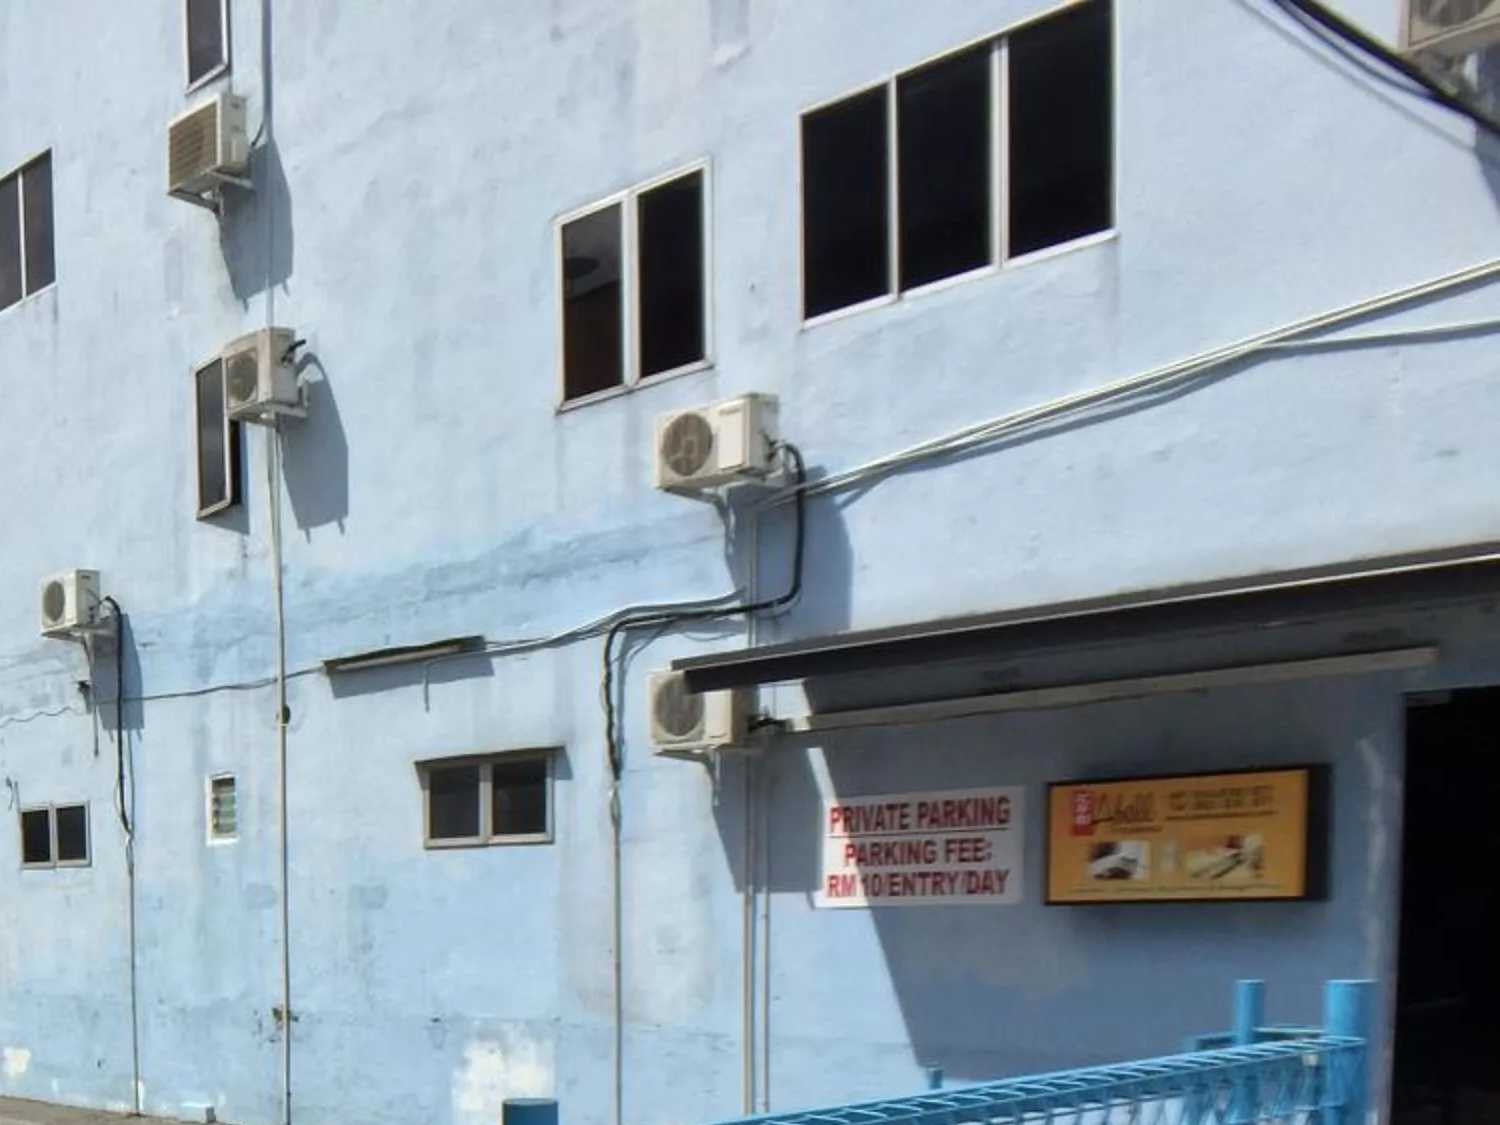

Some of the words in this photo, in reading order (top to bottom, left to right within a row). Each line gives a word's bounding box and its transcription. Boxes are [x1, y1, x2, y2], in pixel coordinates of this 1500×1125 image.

[829, 803, 910, 833] PRIVATE
[917, 797, 1010, 829] PARKING
[845, 839, 937, 866] PARKING
[945, 837, 993, 863] FEE:
